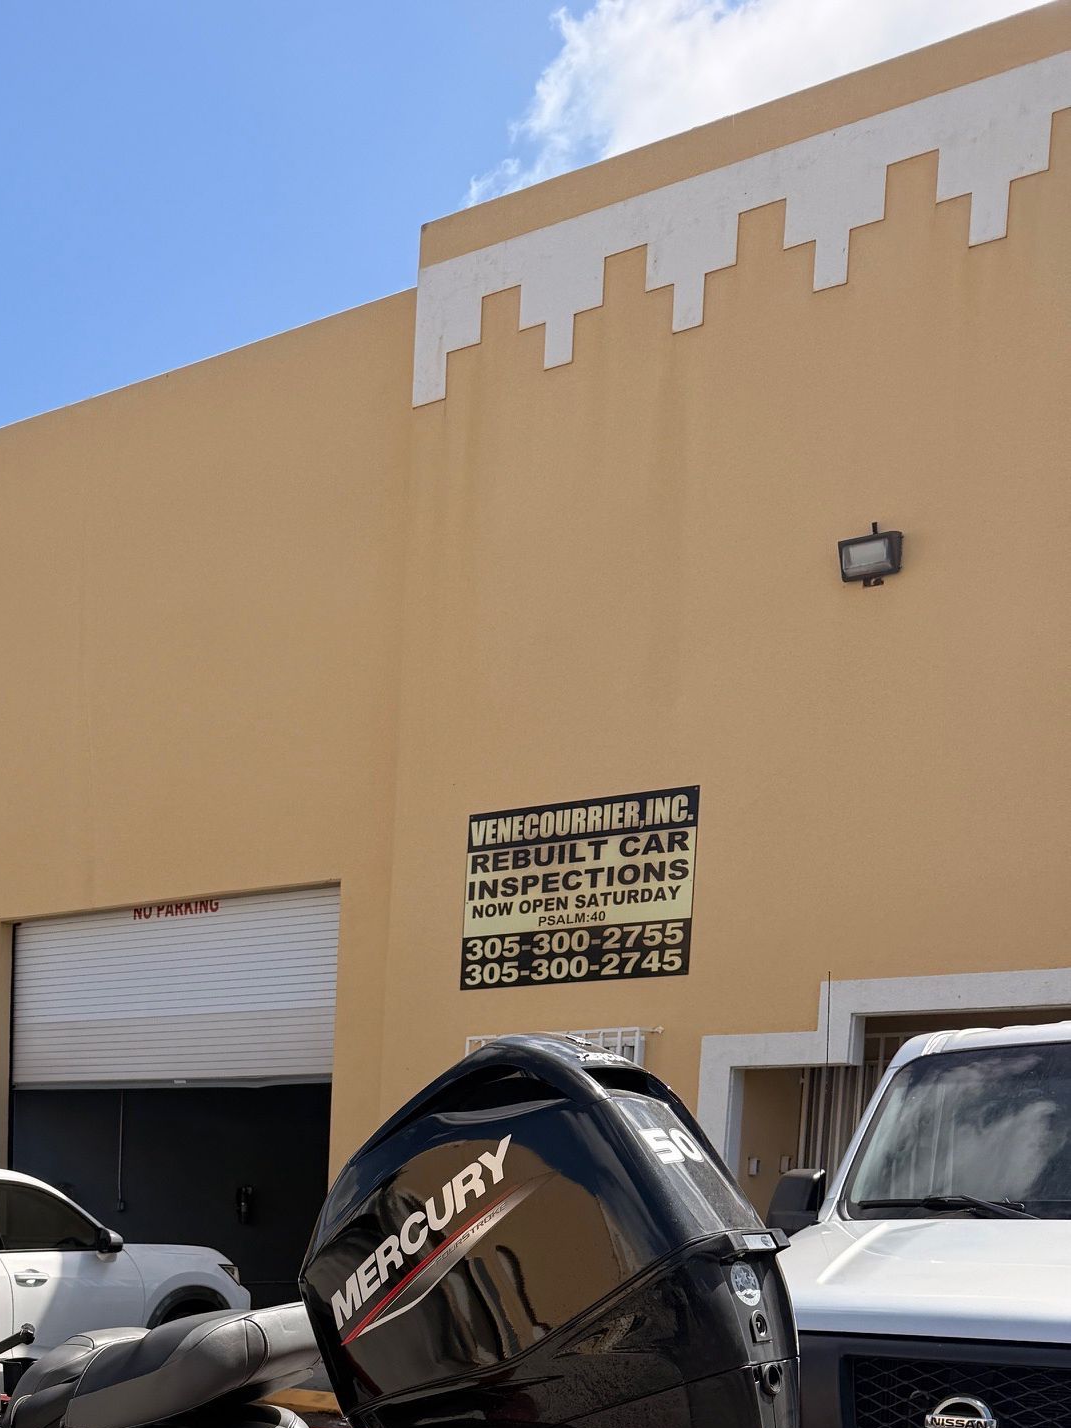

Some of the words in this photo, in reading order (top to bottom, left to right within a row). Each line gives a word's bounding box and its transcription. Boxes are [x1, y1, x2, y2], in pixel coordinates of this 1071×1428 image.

[470, 794, 694, 847] VENECOURRIER,INC.
[470, 839, 608, 875] REBUILT
[619, 830, 690, 858] CAR
[467, 858, 690, 901] INSPECTIONS
[133, 906, 153, 920] NO
[156, 899, 220, 918] PARKING
[472, 901, 513, 919] NOW
[519, 896, 568, 914] OPEN
[574, 885, 681, 909] SATURDAY
[538, 910, 606, 927] PSALM:40
[465, 922, 684, 961] 305-300-2755
[464, 948, 683, 986] 305-300-2745
[638, 1127, 705, 1165] 50
[331, 1133, 512, 1331] MERCURY
[434, 1201, 507, 1266] FOURSTROKE
